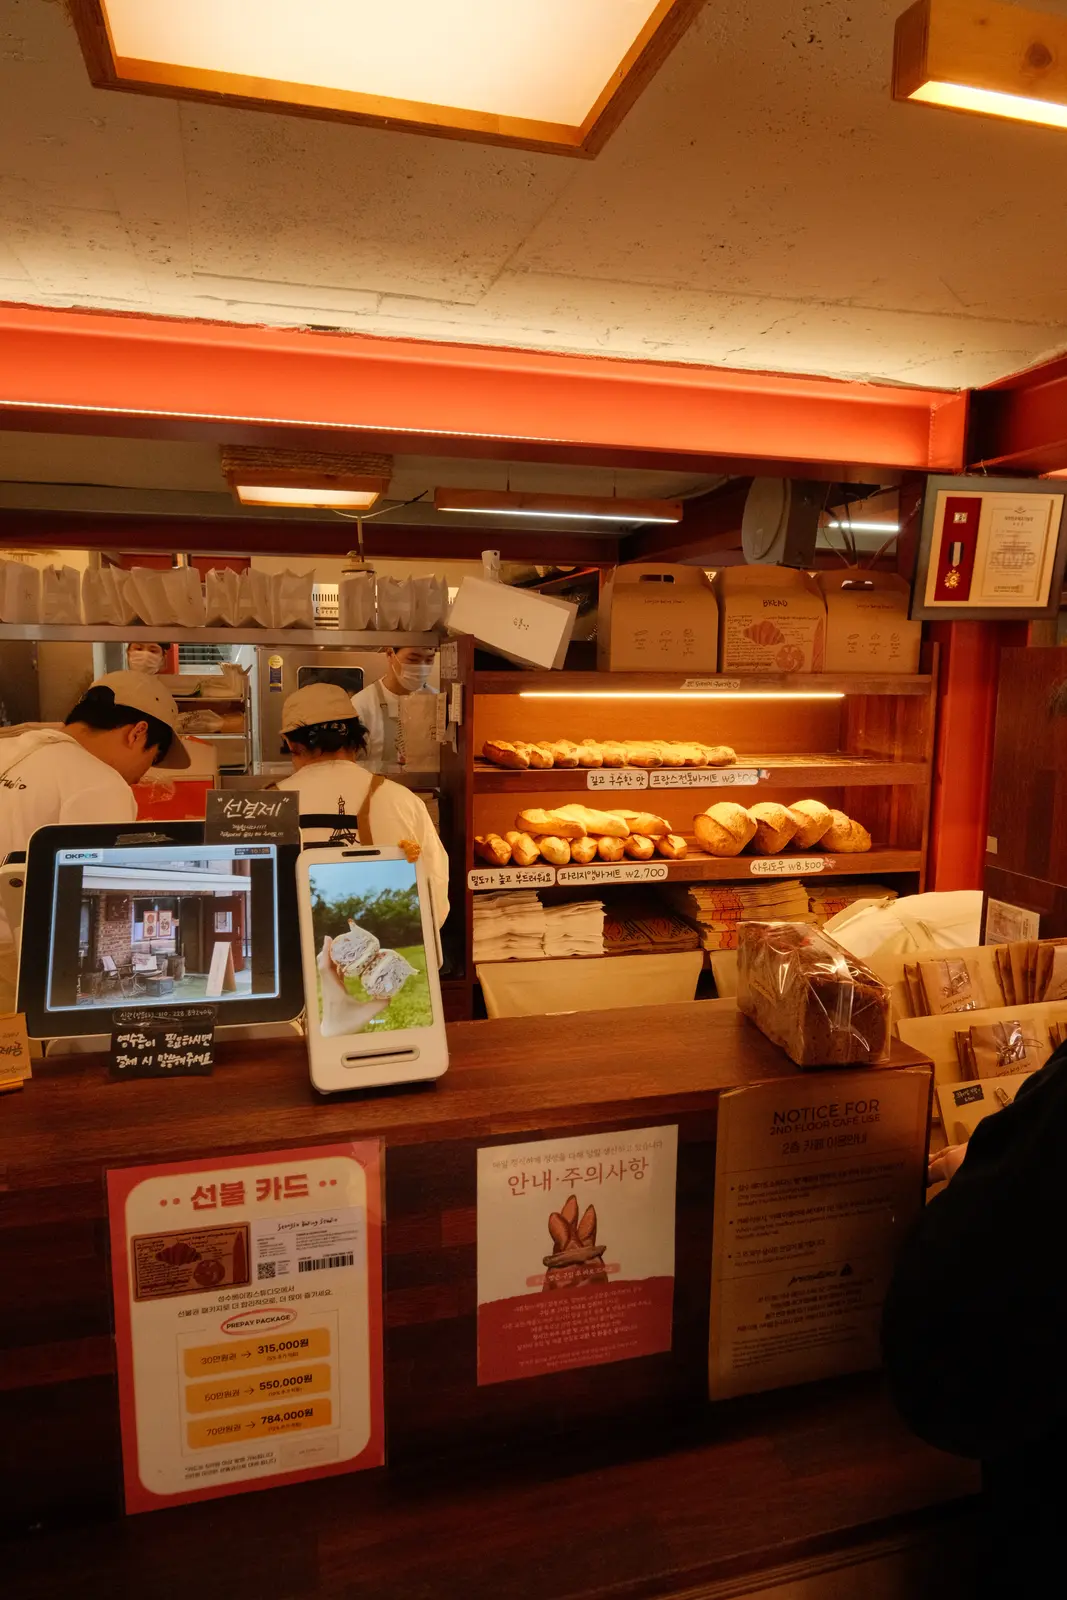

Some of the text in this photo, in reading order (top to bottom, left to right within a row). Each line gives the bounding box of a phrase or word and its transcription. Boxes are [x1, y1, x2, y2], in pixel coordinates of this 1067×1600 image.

[763, 599, 788, 607] BREAD
[609, 773, 632, 786] 구수한
[653, 774, 718, 786] 프랑스전통바게트
[65, 852, 98, 860] OKPOS
[752, 861, 785, 872] 사워도우
[471, 876, 494, 886] 밀도가
[516, 873, 552, 884] 부드러워요
[560, 869, 622, 881] 파리지앵바게트
[117, 1032, 212, 1049] 영수증이 필요하시면
[116, 1054, 138, 1068] 결제
[142, 1055, 153, 1066] 시
[774, 1099, 880, 1124] NOTICE FOR
[769, 1126, 792, 1136] 2ND
[795, 1120, 830, 1133] FLOOR
[861, 1113, 881, 1124] USE
[191, 1174, 309, 1210] 선불 카드
[226, 1314, 291, 1329] PREPAY PACKAGE
[257, 1338, 309, 1355] 315,000원
[259, 1374, 313, 1391] 550,000원
[260, 1408, 314, 1425] 784,000원
